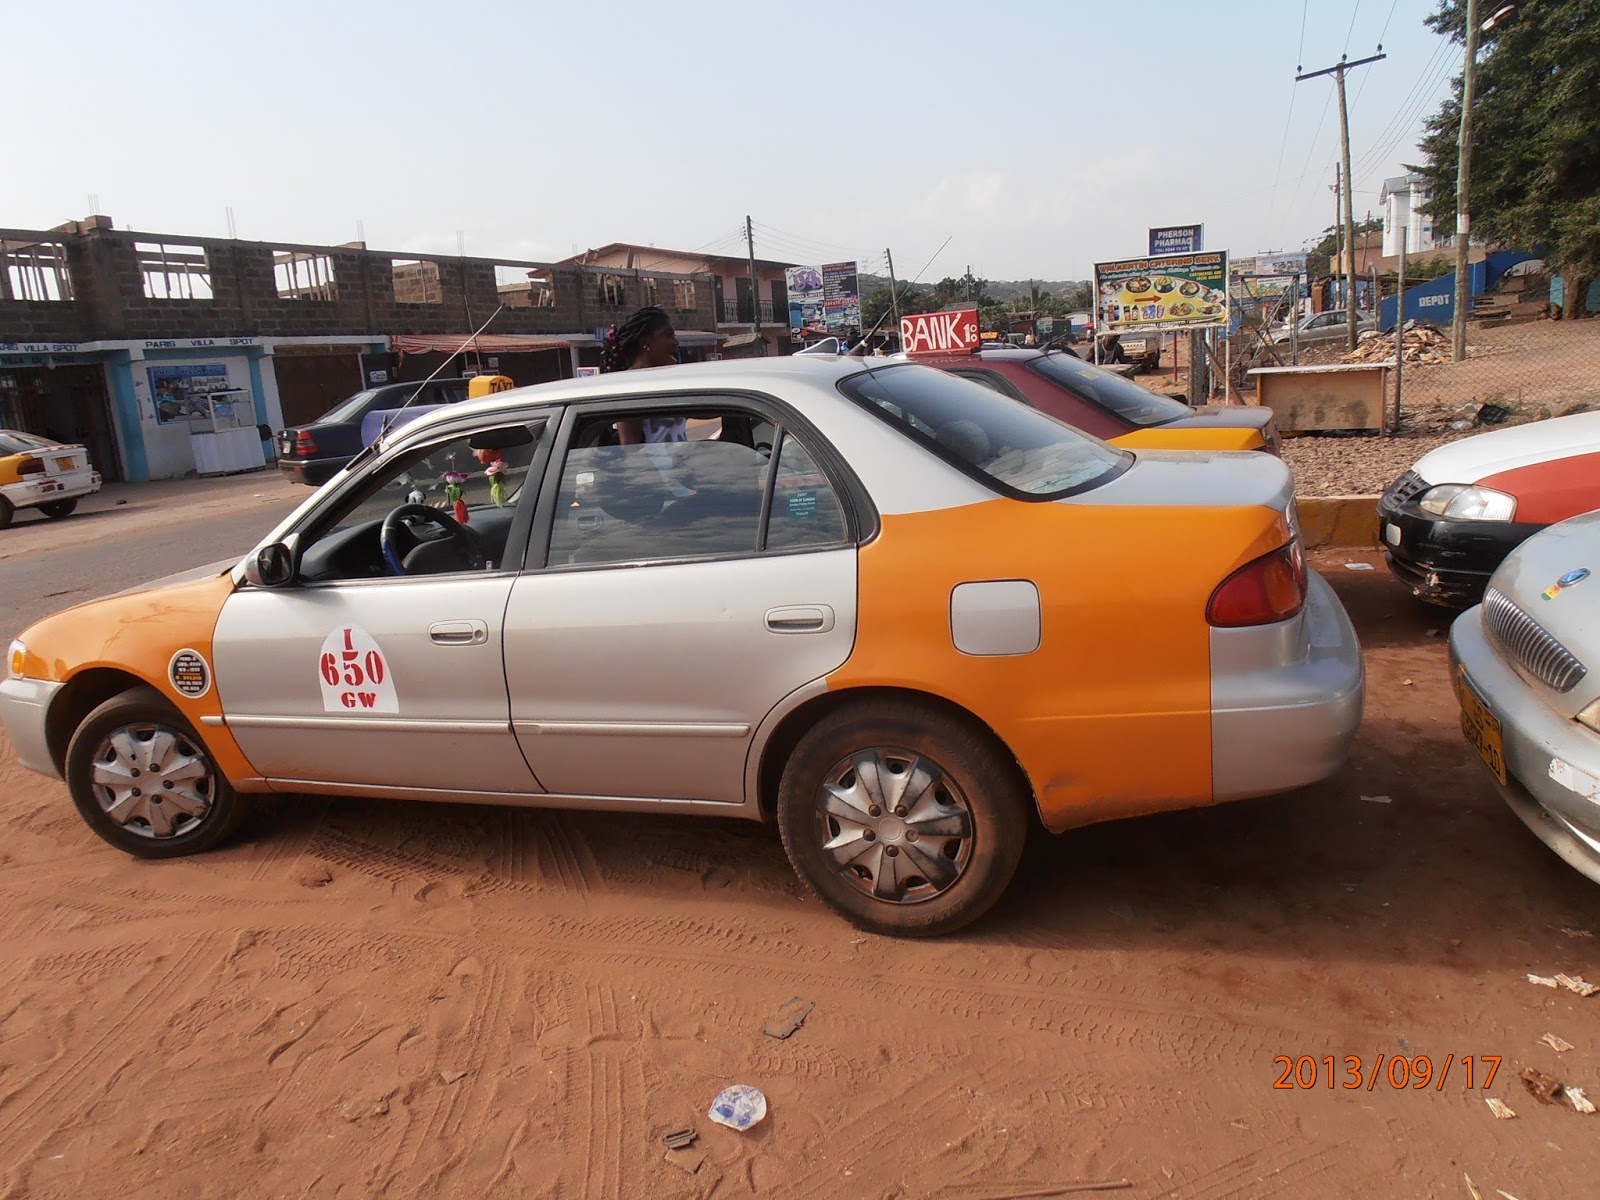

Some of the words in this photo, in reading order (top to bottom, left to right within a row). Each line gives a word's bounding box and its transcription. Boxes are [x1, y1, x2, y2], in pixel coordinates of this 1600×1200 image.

[1157, 229, 1194, 239] PHERSON
[1154, 237, 1193, 247] PHARMAC
[1149, 257, 1193, 269] CATERING
[1419, 294, 1450, 308] DEPOT
[901, 313, 965, 353] BANK
[23, 344, 49, 352] VILLA
[53, 344, 78, 352] SPOT
[190, 339, 215, 347] VILLA
[491, 382, 512, 394] TAXI
[321, 650, 384, 686] 650
[341, 692, 376, 708] GW
